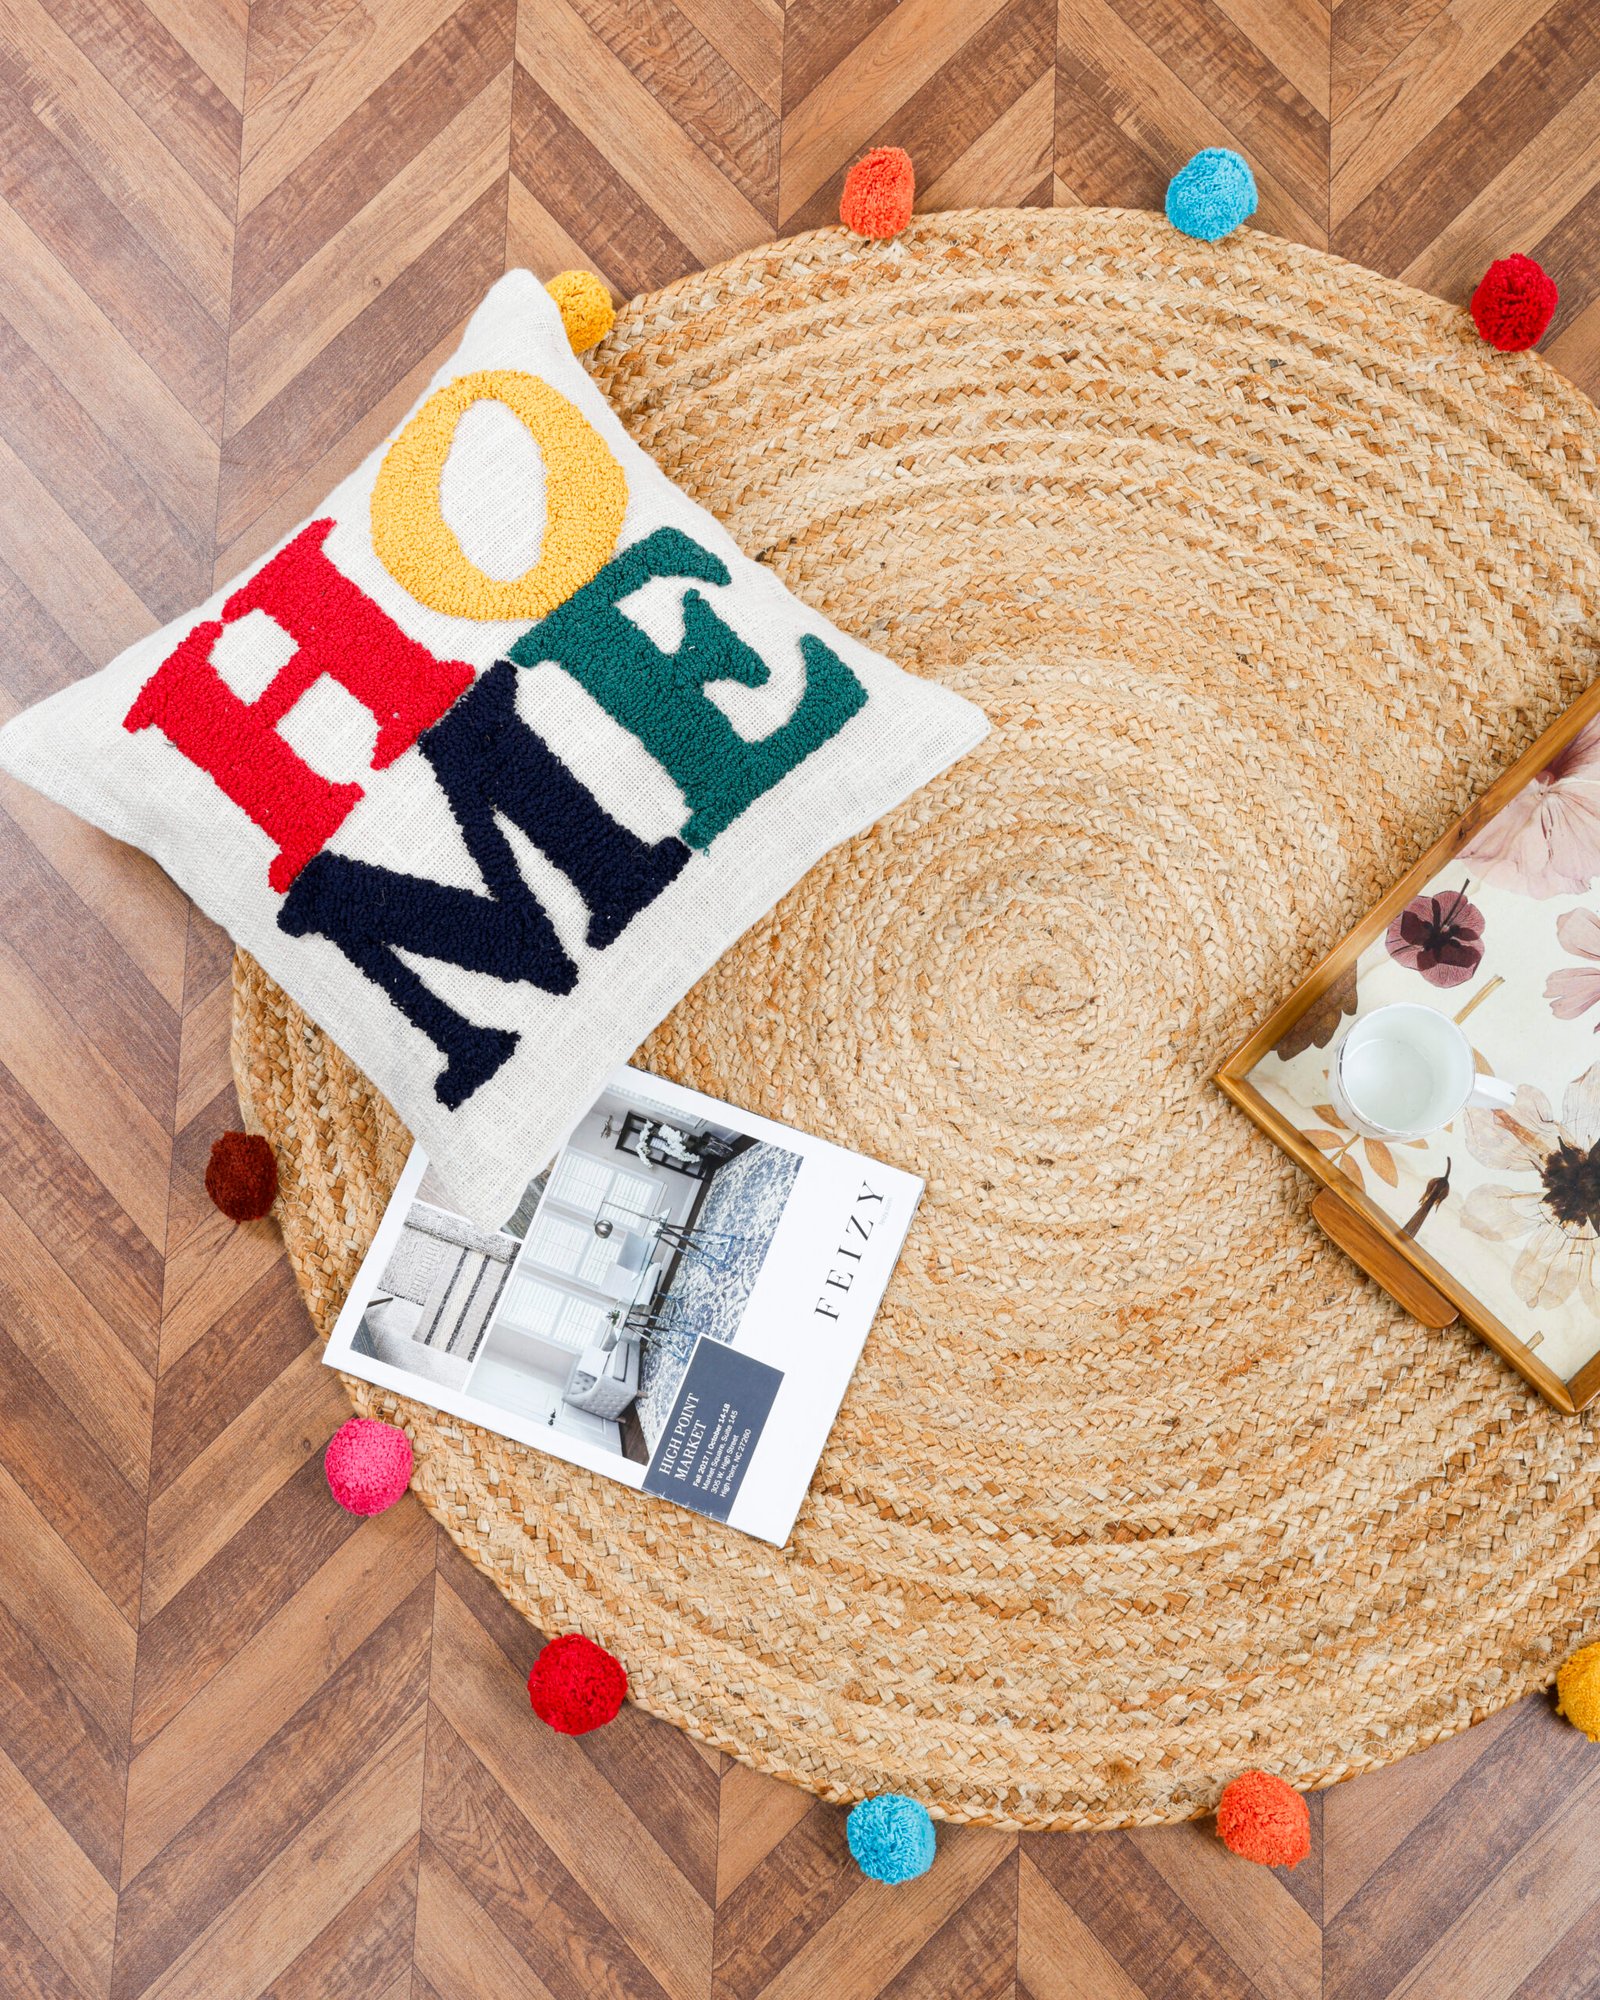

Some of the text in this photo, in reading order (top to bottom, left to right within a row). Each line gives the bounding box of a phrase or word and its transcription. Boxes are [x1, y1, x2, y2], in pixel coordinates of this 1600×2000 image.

[814, 1180, 884, 1322] FEIZY
[658, 1393, 699, 1475] HIGH POINT
[674, 1419, 706, 1481] MARKET
[692, 1474, 702, 1487] Fall
[698, 1455, 709, 1474] 2017
[708, 1424, 722, 1450] October
[718, 1403, 730, 1424] 14-18
[701, 1467, 716, 1490] Market
[721, 1425, 732, 1442] Suite
[728, 1410, 738, 1424] 145
[711, 1435, 739, 1494] 305 W. High Street
[720, 1482, 730, 1497] High
[734, 1452, 742, 1462] NC
[738, 1429, 751, 1452] 27260
